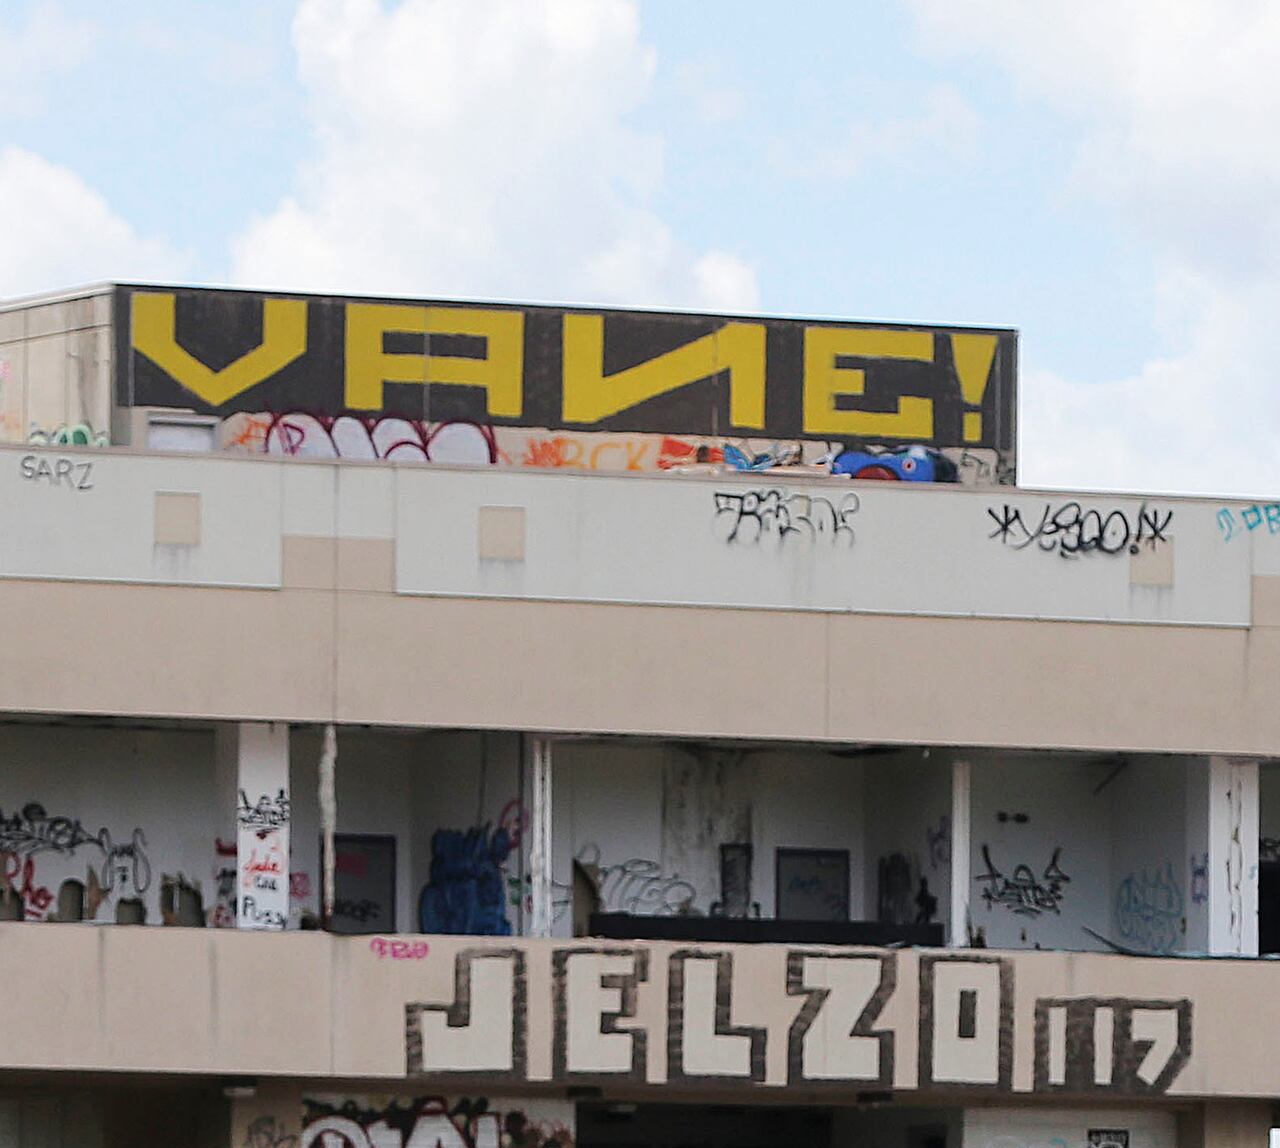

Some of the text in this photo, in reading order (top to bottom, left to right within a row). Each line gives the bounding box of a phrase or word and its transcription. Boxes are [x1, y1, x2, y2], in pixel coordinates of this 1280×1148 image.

[131, 291, 998, 441] VANE!
[21, 455, 93, 491] SARZ
[405, 947, 1018, 1088] JELZO
